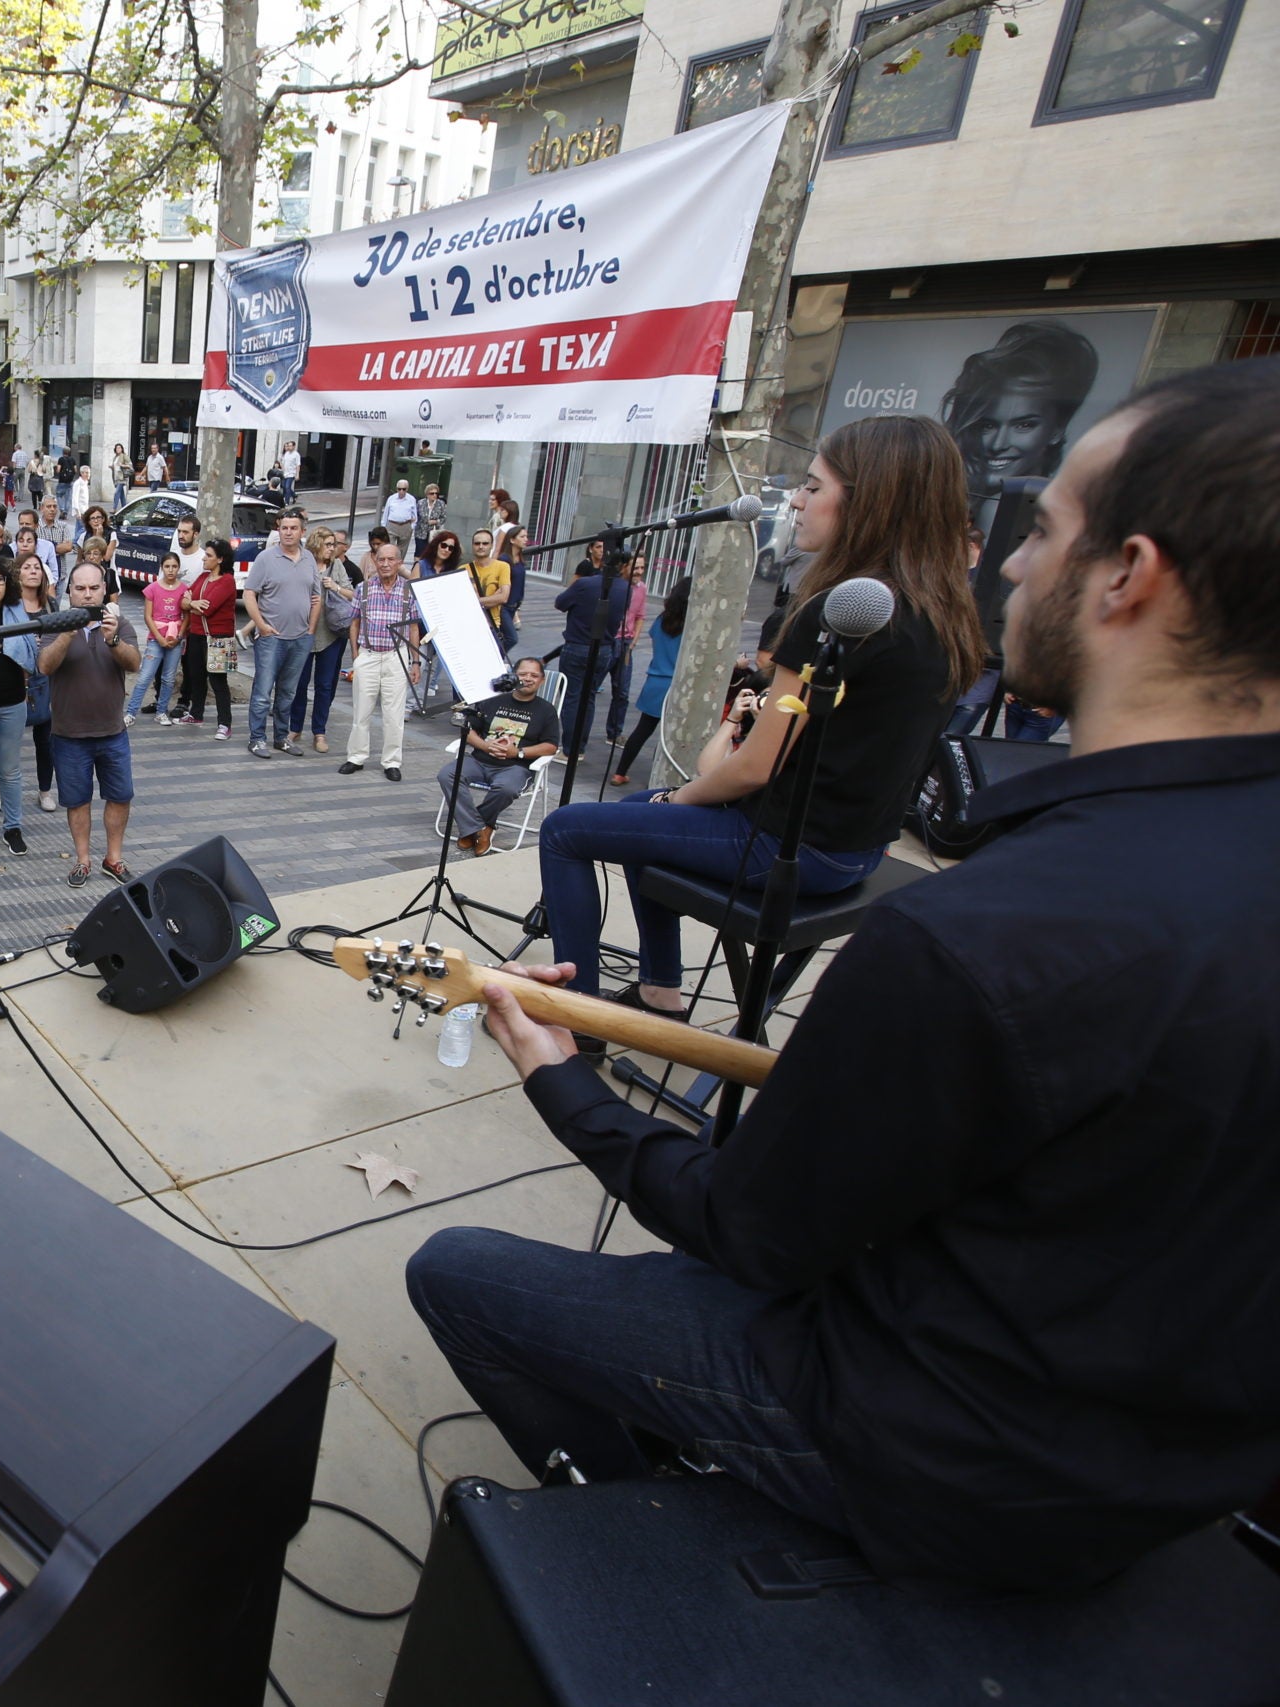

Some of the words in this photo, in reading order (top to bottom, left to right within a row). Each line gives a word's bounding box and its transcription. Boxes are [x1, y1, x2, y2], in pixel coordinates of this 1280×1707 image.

[539, 20, 593, 44] ARQUITECTURA
[594, 14, 609, 27] DEL
[527, 117, 621, 175] dorsia
[353, 230, 409, 287] 30
[411, 227, 442, 261] de
[444, 199, 586, 255] setembre,
[237, 282, 295, 323] DENIM
[404, 274, 429, 322] 1
[430, 278, 439, 310] i
[446, 265, 475, 316] 2
[484, 249, 620, 303] d'octubre
[271, 327, 295, 347] LIFE
[359, 352, 385, 381] LA
[389, 345, 476, 381] CAPITAL
[477, 339, 525, 376] DEL
[539, 320, 618, 372] TEXÀ
[844, 380, 918, 409] dorsia
[466, 412, 494, 421] Ajuntament
[132, 549, 158, 563] d'esquadra
